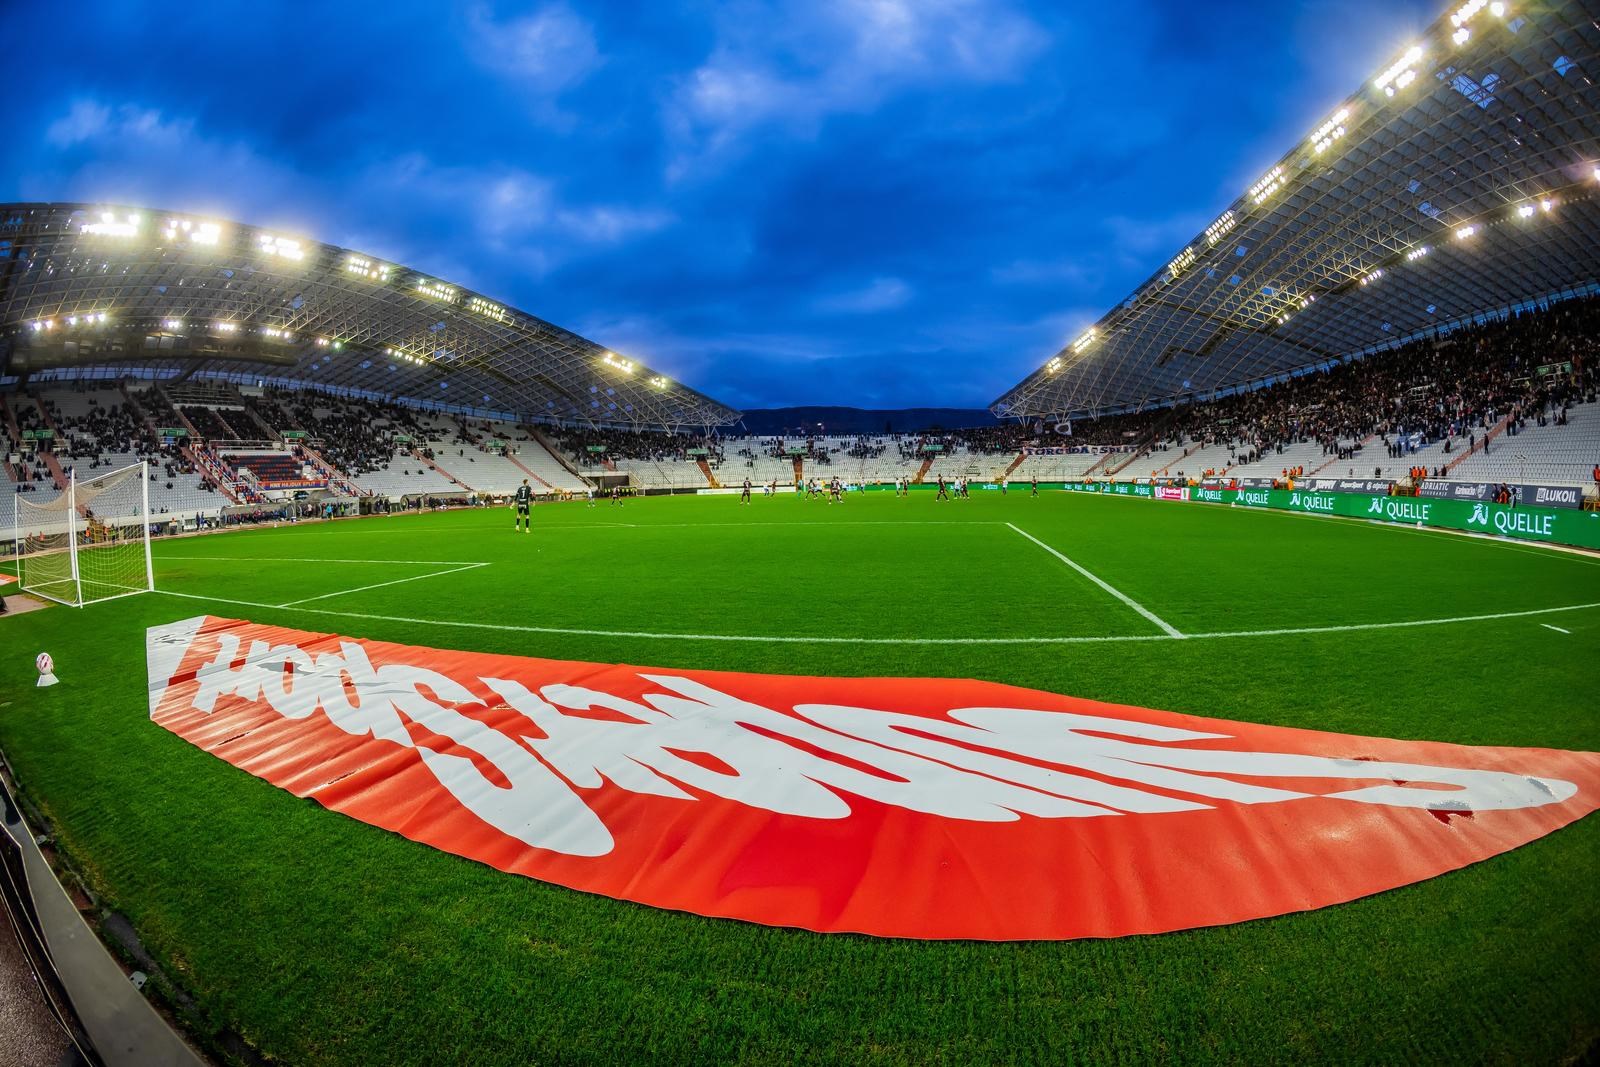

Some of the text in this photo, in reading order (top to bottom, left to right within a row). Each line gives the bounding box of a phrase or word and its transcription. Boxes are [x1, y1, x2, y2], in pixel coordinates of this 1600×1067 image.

[1421, 482, 1449, 491] ADRIATIC
[1204, 490, 1221, 500] QUELLE
[1245, 492, 1268, 504] QUELLE
[1545, 489, 1576, 502] LUKOIL
[1303, 496, 1334, 510] QUELLE
[1386, 502, 1429, 520] QUELLE
[1494, 511, 1552, 535] QUELLE
